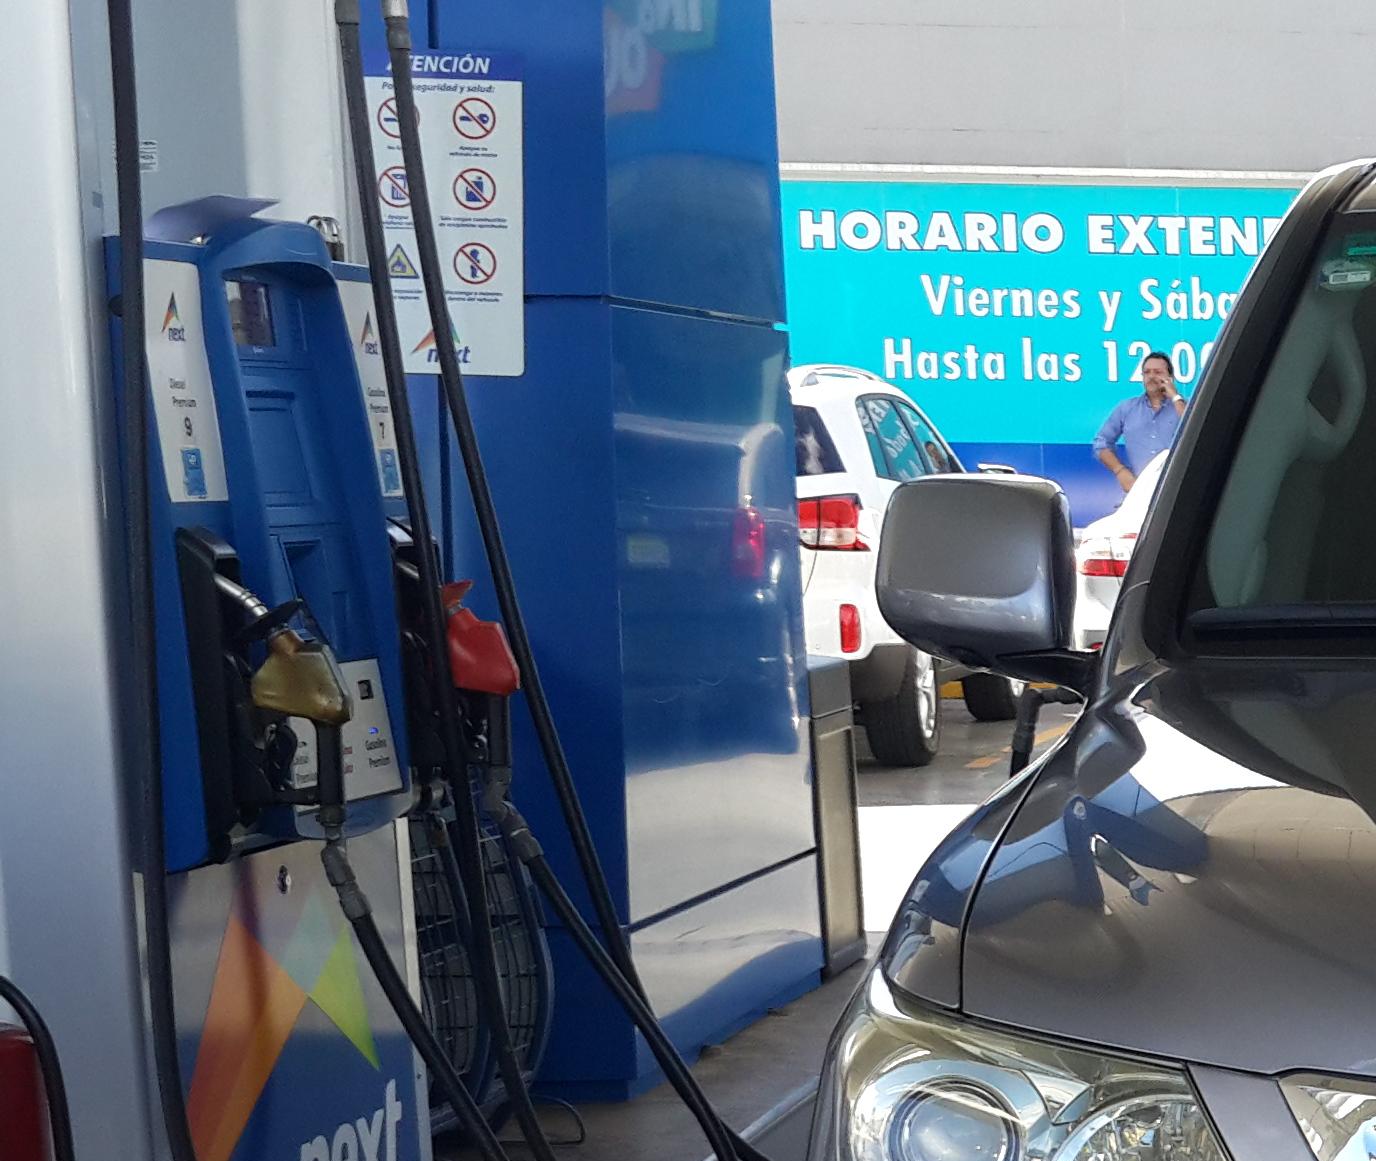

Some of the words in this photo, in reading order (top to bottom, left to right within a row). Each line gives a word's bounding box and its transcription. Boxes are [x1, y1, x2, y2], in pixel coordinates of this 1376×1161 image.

[387, 53, 490, 74] ENCIÓN
[799, 209, 1065, 254] HORARIO
[919, 273, 1081, 319] Viernes
[1098, 290, 1122, 332] y
[427, 345, 472, 364] nxt
[882, 337, 1006, 380] Hasta
[1021, 336, 1082, 382] las
[183, 416, 193, 437] 9
